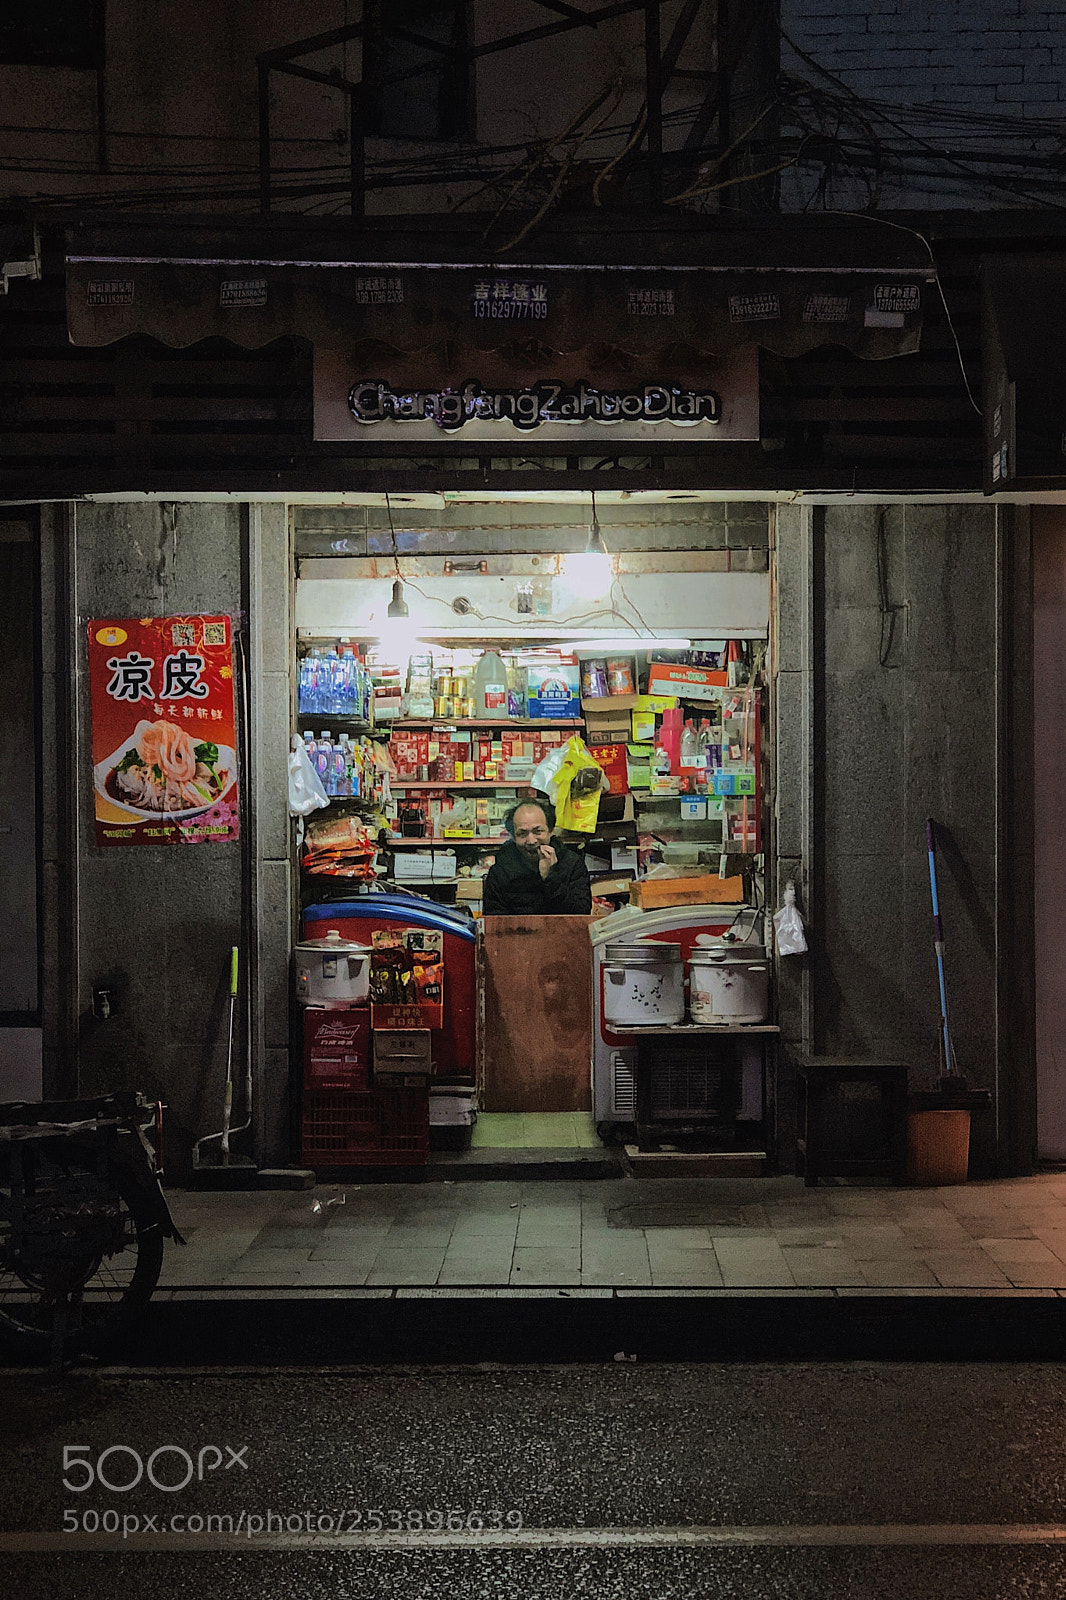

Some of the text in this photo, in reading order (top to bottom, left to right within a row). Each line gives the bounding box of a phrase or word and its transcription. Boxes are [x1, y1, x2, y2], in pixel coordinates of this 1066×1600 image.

[473, 281, 548, 301] 吉祥篷业
[350, 381, 721, 430] ChangfengZahuoDian
[107, 649, 210, 701] 凉皮
[153, 703, 224, 720] 每天都新鲜
